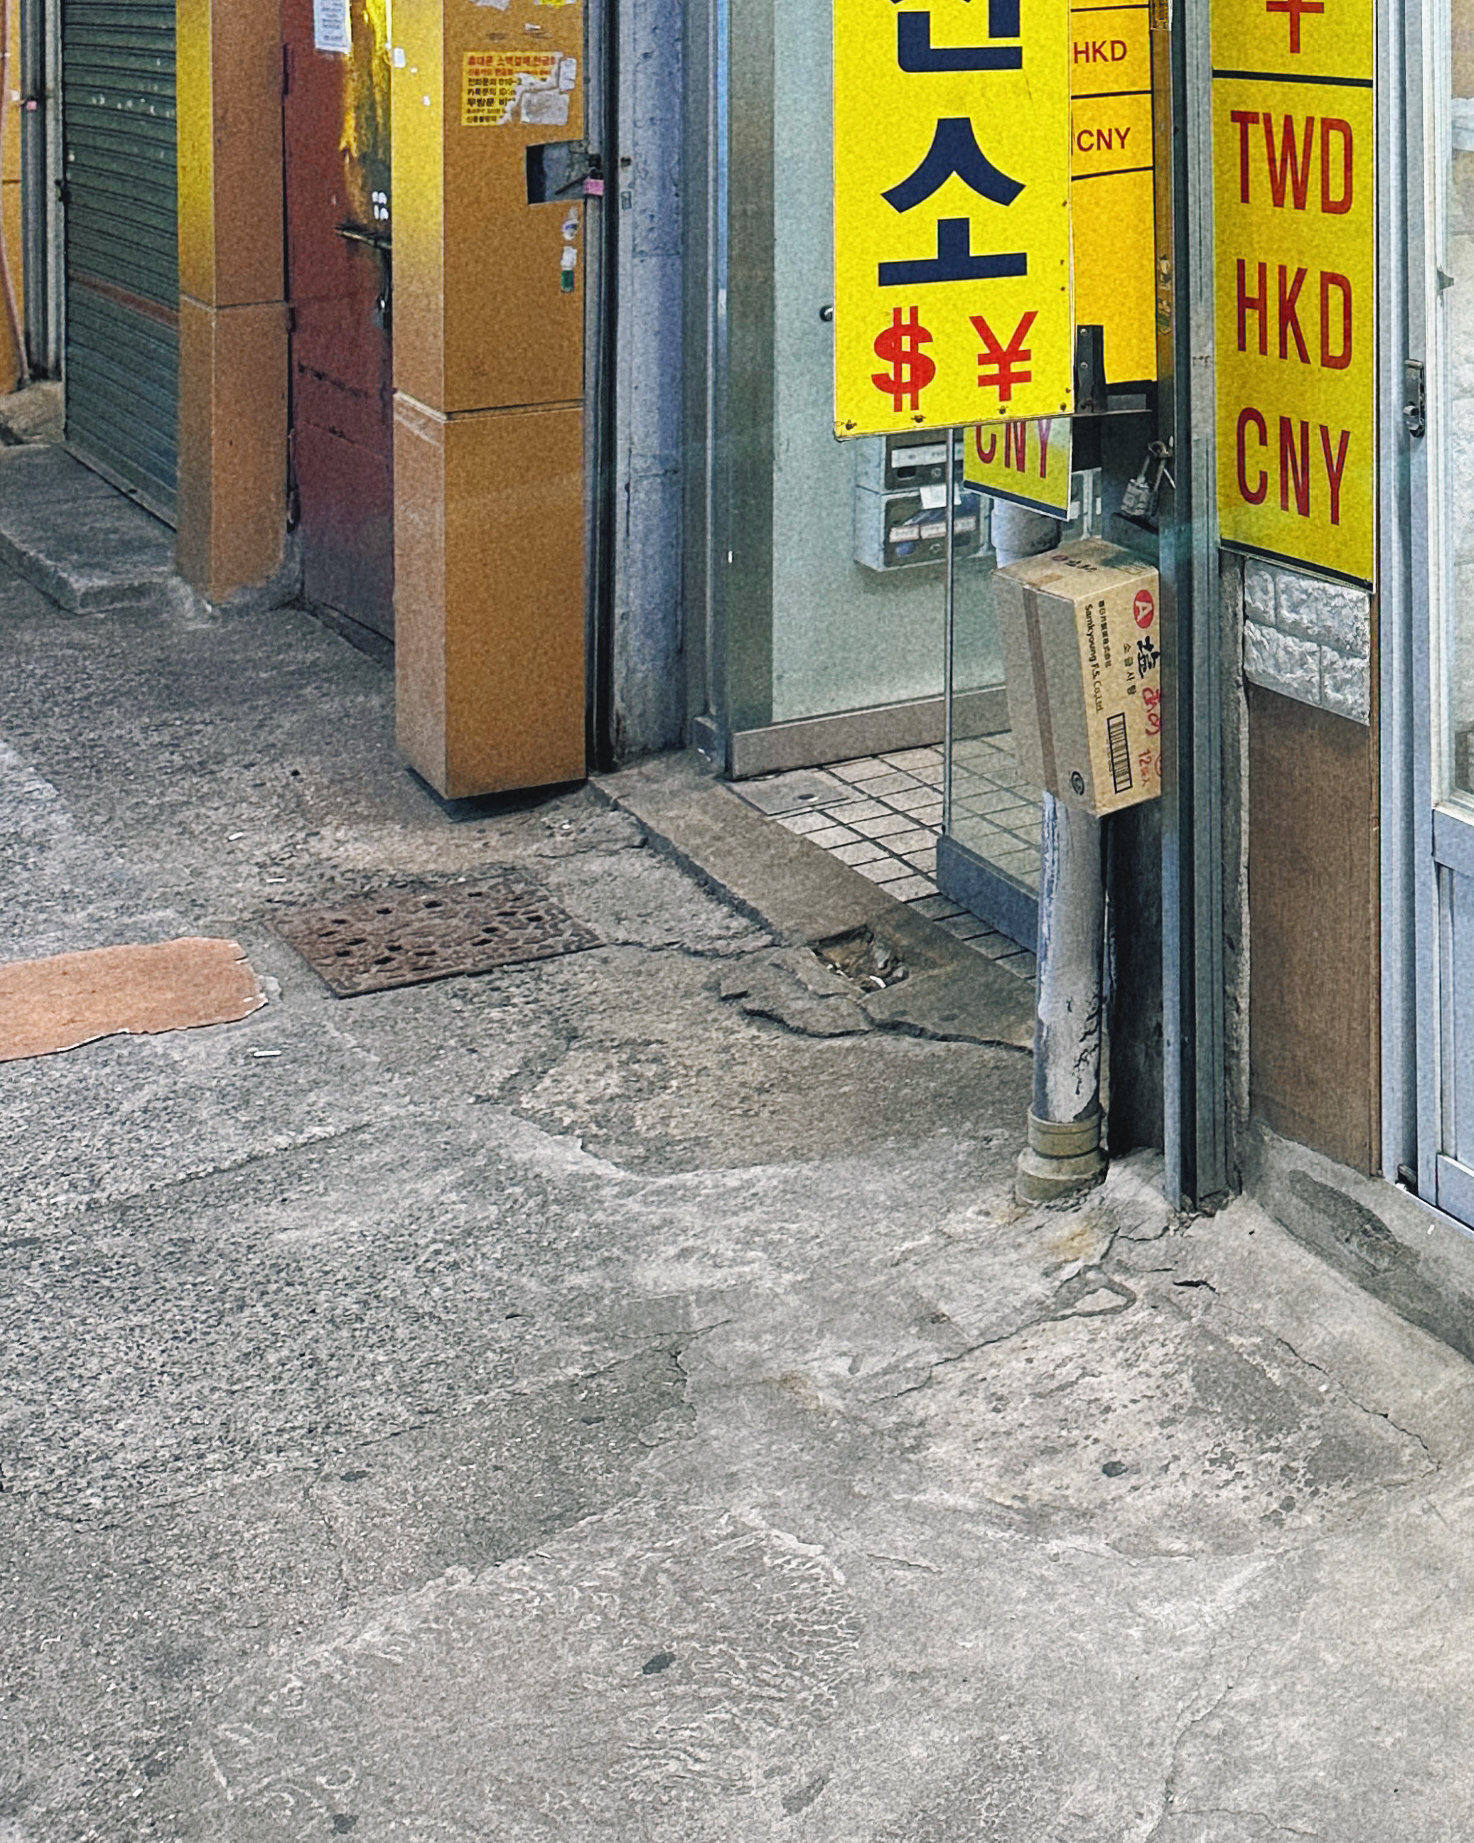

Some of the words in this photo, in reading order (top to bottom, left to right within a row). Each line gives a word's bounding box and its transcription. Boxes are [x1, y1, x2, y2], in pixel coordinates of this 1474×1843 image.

[1073, 40, 1127, 64] HKD
[1076, 128, 1131, 152] CNY
[1229, 109, 1356, 216] TWD
[871, 306, 936, 412] $
[1236, 258, 1354, 370] HKD
[1236, 406, 1348, 526] CNY
